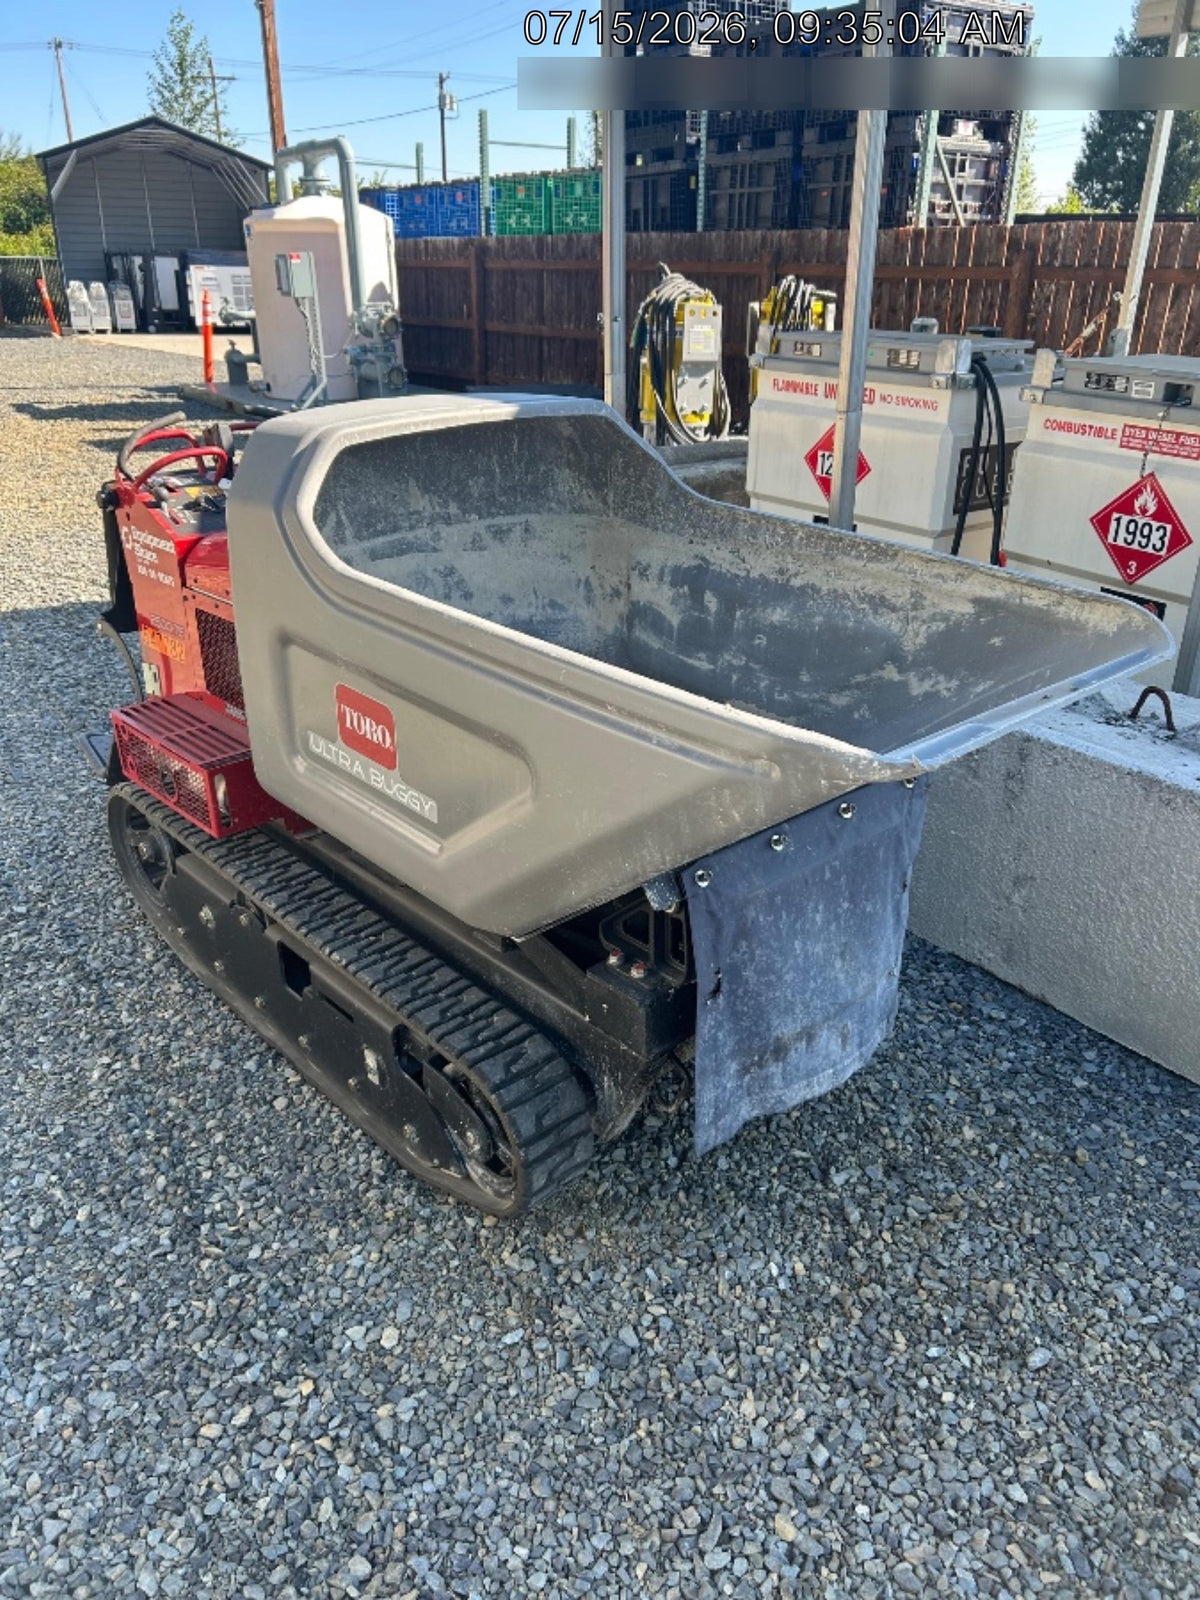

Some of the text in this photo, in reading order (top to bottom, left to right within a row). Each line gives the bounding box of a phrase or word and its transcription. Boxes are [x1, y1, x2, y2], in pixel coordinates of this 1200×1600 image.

[772, 378, 820, 397] FLAMMABLE
[879, 393, 893, 404] NO
[895, 395, 938, 411] SMOKING
[1043, 418, 1118, 440] COMBUSTIBLE
[1112, 515, 1168, 554] 1993
[1126, 561, 1138, 575] 3
[340, 703, 394, 752] TORO
[308, 731, 436, 816] ULTRA BUGGY
